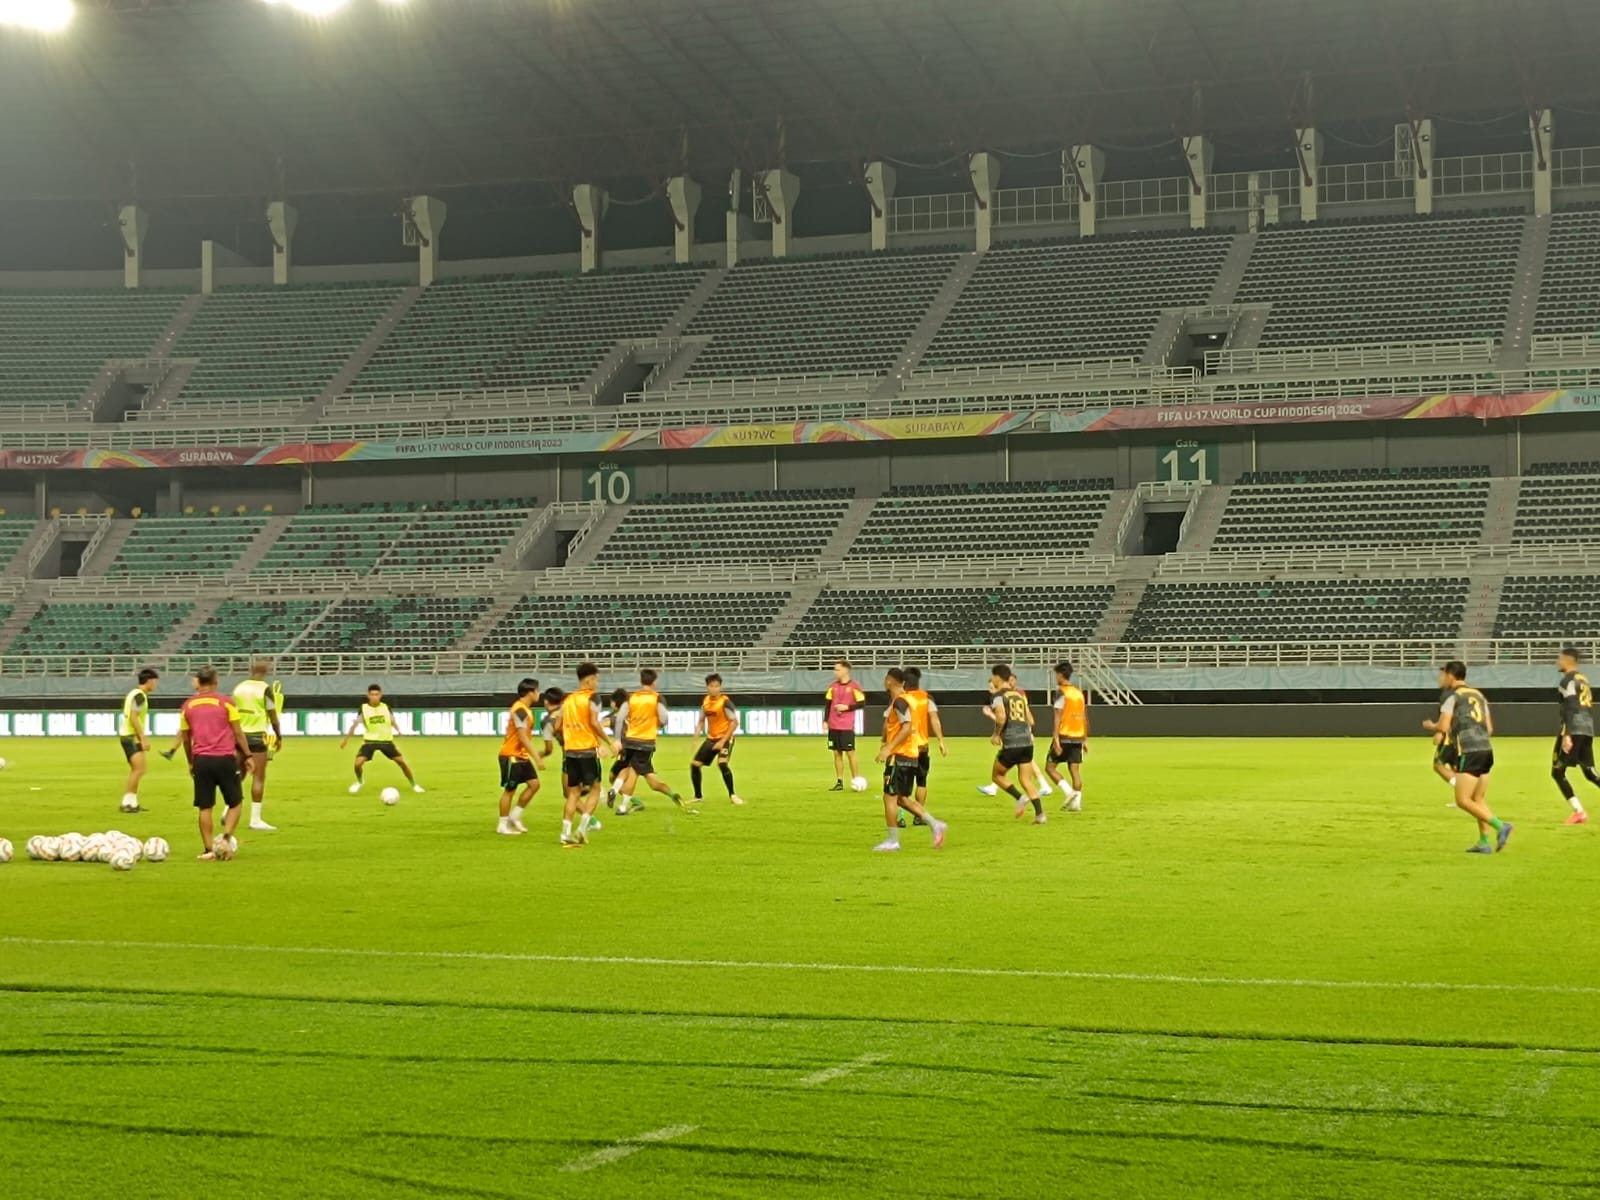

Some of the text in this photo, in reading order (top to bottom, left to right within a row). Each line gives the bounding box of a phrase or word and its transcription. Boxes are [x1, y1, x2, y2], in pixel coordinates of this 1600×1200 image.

[1573, 395, 1600, 406] #U1
[1157, 411, 1183, 422] FIFA
[1184, 410, 1208, 421] U-17
[1210, 408, 1251, 420] WORLD
[1254, 407, 1276, 418] CUP
[1336, 404, 1362, 415] 2023
[905, 421, 965, 434] SURABAYA
[395, 444, 416, 453] FIFA
[417, 443, 438, 453] U-17
[439, 442, 473, 452] WORLD
[475, 441, 493, 450] CUP
[1175, 439, 1199, 448] Gate
[16, 455, 60, 465] #U17WC
[179, 451, 234, 463] SURABAYA
[1161, 449, 1212, 485] 11
[587, 470, 630, 505] 10
[1468, 696, 1482, 723] 3
[746, 710, 789, 734] GOAL
